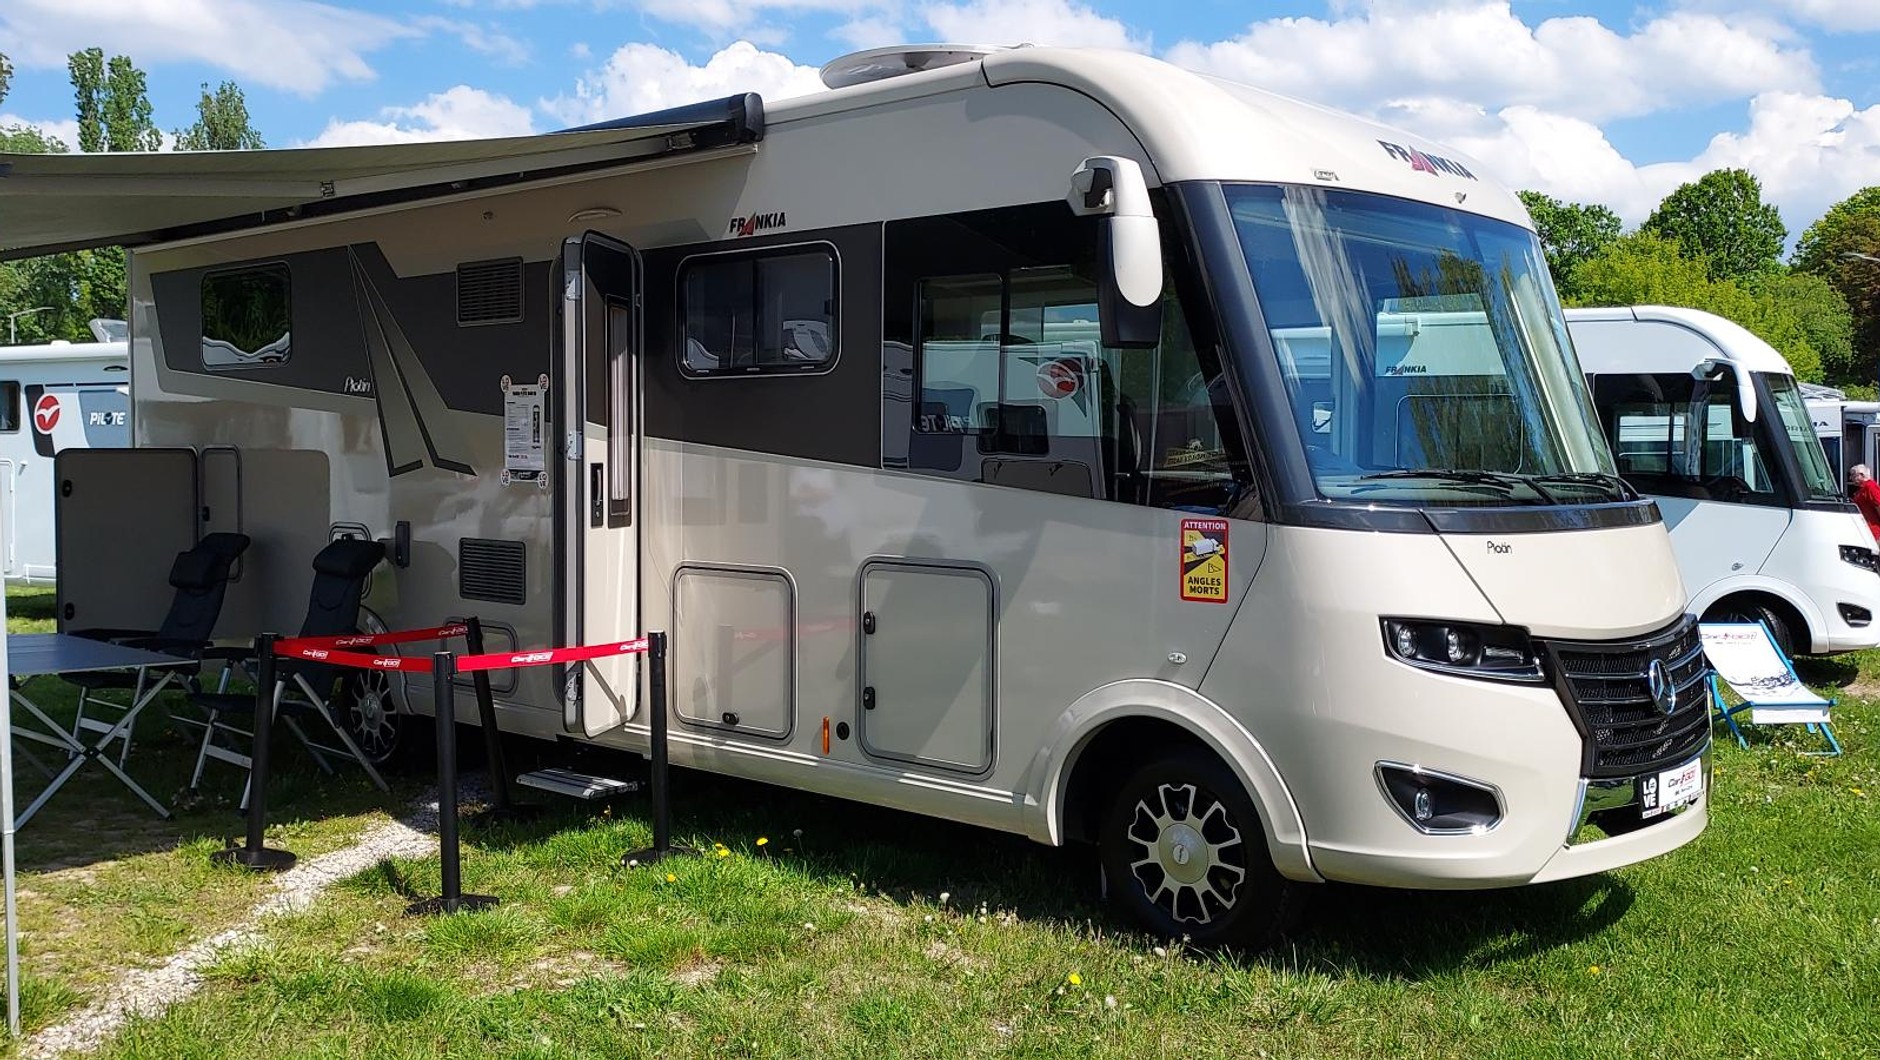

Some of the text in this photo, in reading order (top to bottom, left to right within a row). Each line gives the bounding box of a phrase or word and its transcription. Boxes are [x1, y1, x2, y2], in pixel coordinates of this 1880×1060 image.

[1375, 139, 1478, 181] FRANKIA
[729, 211, 787, 237] FRANKIA
[1385, 363, 1427, 376] FRANKIA
[1184, 521, 1227, 530] ATTENTION
[1187, 576, 1222, 587] ANGLES
[1189, 586, 1221, 595] MORTS
